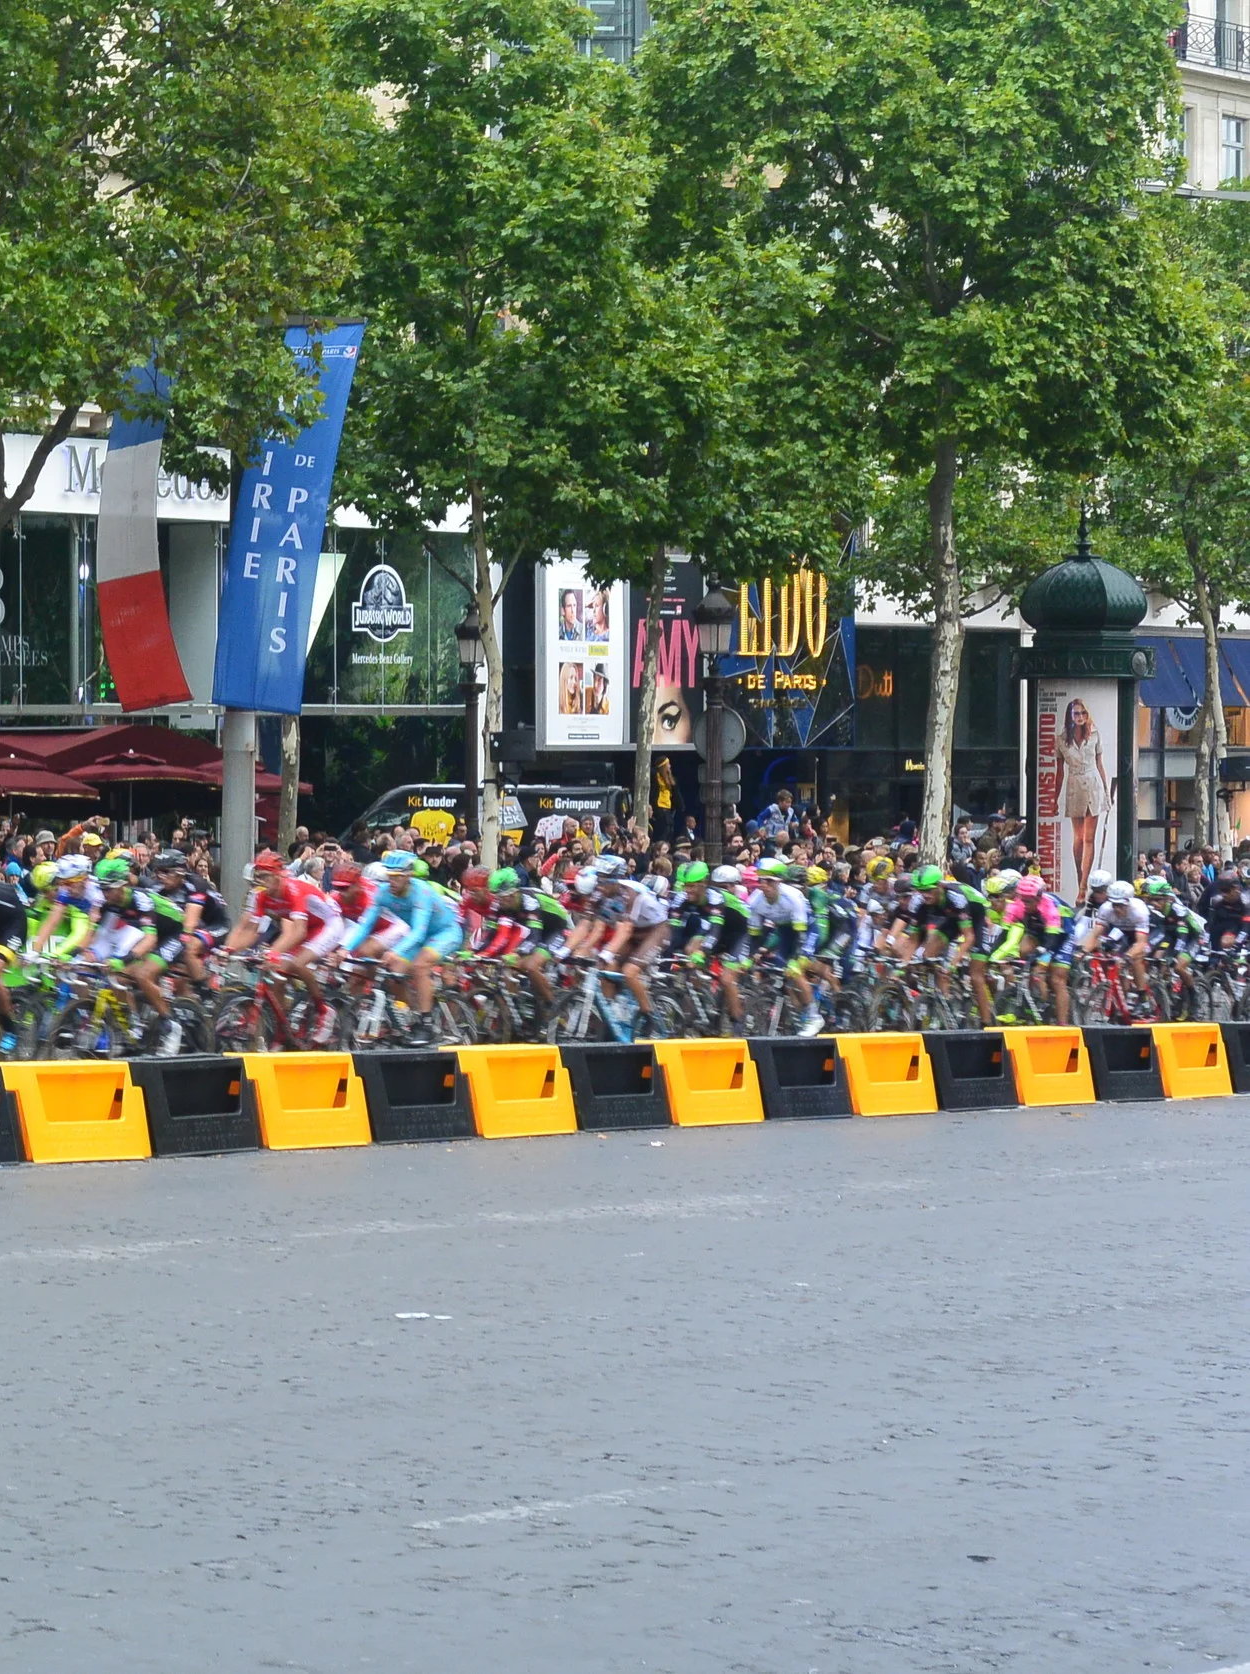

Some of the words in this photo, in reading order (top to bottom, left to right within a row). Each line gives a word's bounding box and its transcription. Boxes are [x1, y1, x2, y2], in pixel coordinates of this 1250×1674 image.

[295, 454, 316, 468] DE
[269, 487, 309, 654] PARIS
[355, 608, 384, 626] JURASSIC
[384, 608, 411, 626] WORLD
[352, 652, 393, 665] Mercedes-Benz
[393, 652, 413, 667] Gallery
[747, 673, 766, 690] DE
[408, 796, 422, 807] Kit
[423, 795, 457, 807] Leader
[1039, 772, 1055, 818] DANS
[539, 797, 553, 809] Kit
[554, 797, 601, 811] Grimpeur
[1038, 822, 1054, 868] DAME
